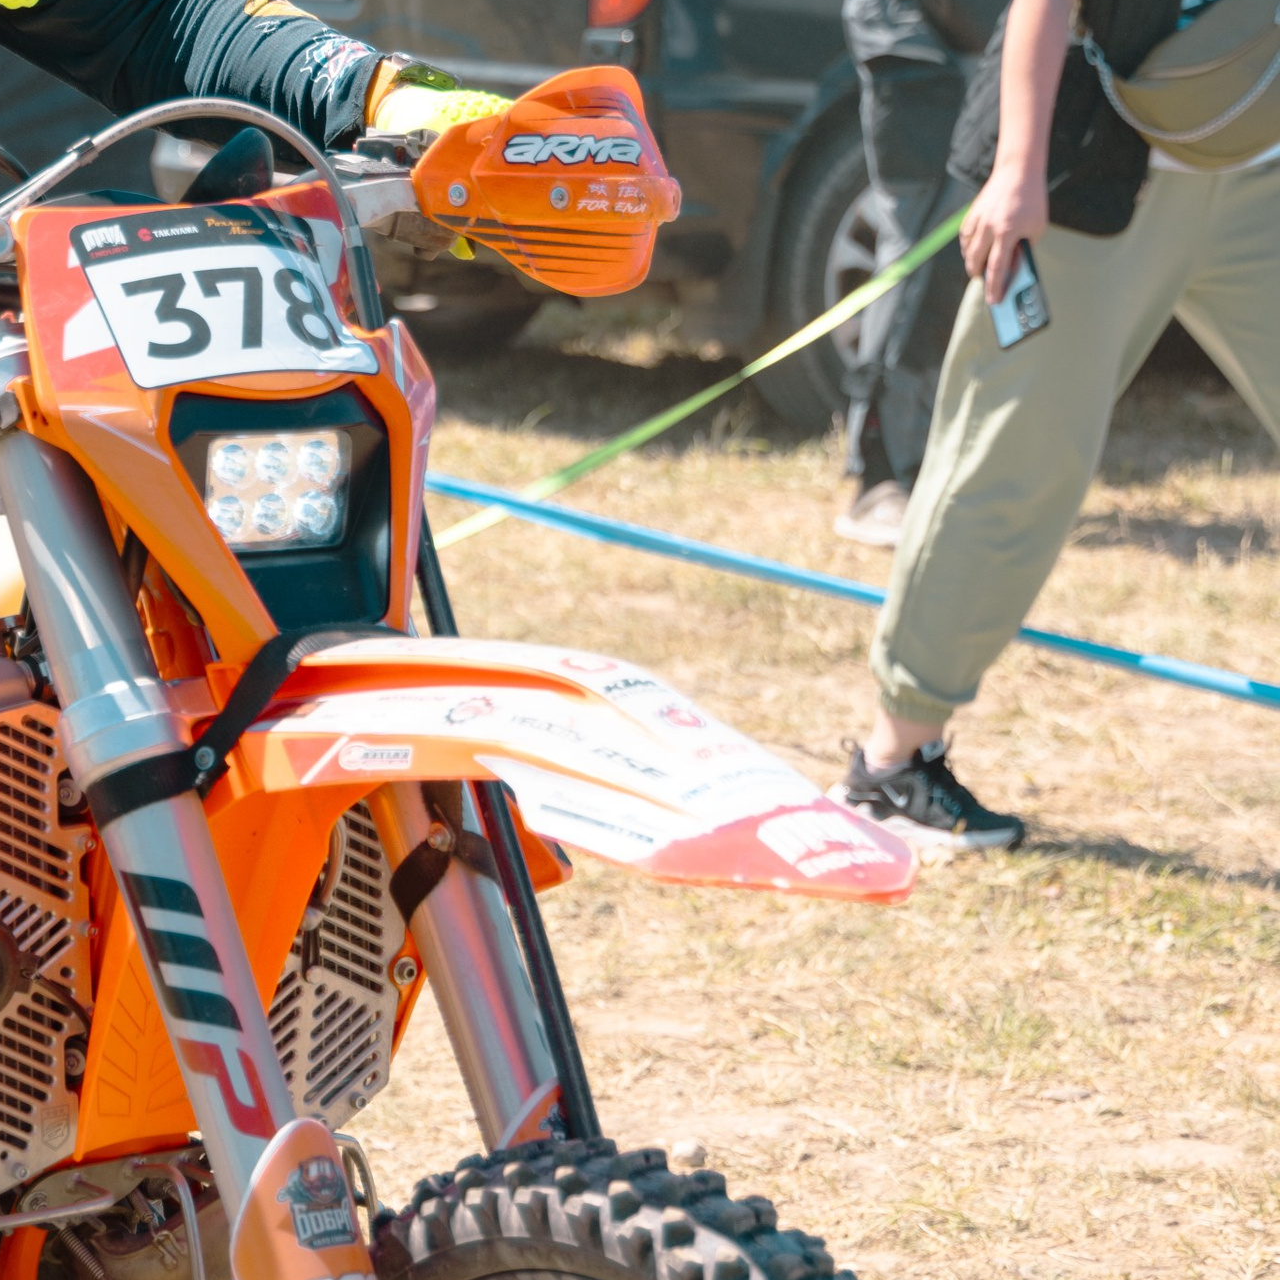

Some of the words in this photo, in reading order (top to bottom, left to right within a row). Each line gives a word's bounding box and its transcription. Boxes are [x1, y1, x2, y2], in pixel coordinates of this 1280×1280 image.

[577, 199, 609, 212] FOR
[152, 226, 199, 238] TAKAYAMA
[121, 267, 343, 360] 378
